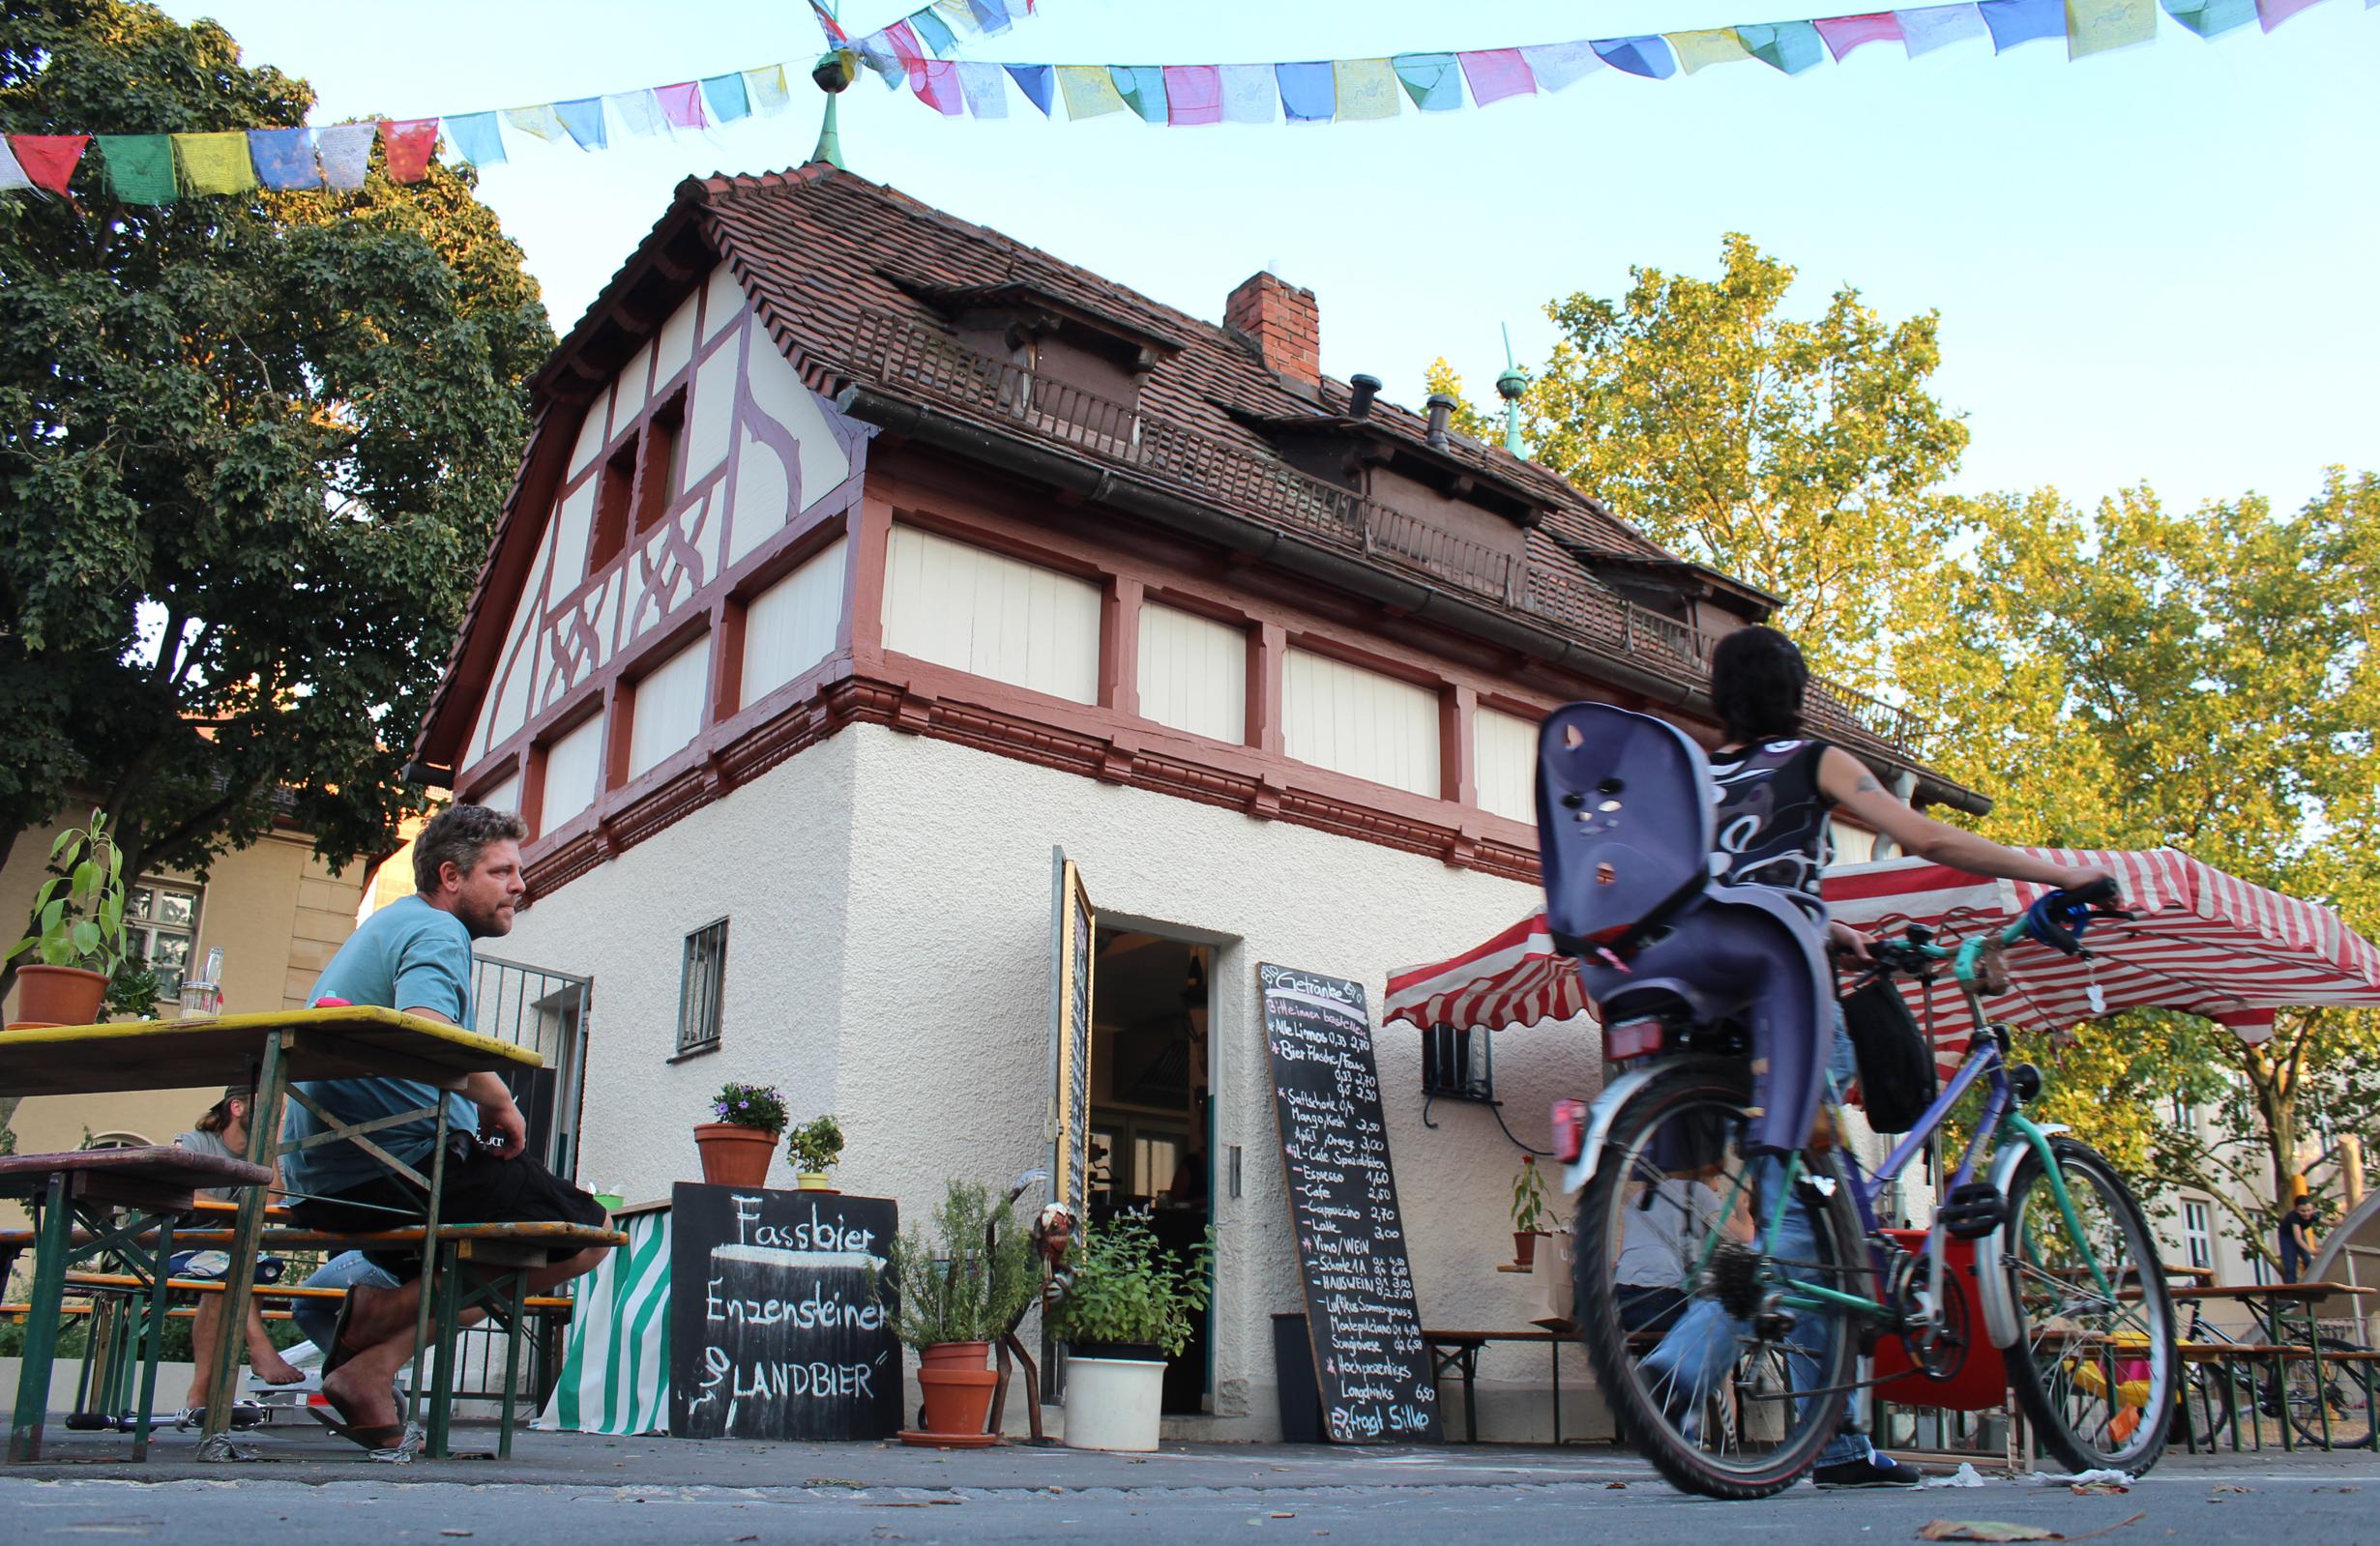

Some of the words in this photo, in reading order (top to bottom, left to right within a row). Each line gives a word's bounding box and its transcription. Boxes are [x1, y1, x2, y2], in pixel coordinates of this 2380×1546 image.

[1276, 972, 1352, 1004] Getränke
[1276, 1018, 1294, 1036] Alle
[1293, 1021, 1328, 1044] Limos
[1329, 1032, 1347, 1048] 0,33
[1350, 1036, 1369, 1053] 2,70
[1279, 1039, 1306, 1061] Bier
[1335, 1068, 1353, 1084] 0,33
[1355, 1072, 1375, 1089] 2,70
[1339, 1100, 1355, 1118] 0,4
[1356, 1119, 1380, 1134] 3,50
[1360, 1136, 1384, 1153] 3,00
[1303, 1165, 1344, 1183] Espresso
[1366, 1171, 1389, 1187] 1,60
[1367, 1187, 1391, 1203] 2,50
[1308, 1200, 1361, 1219] Cappuccino
[1370, 1207, 1395, 1223] 2,70
[730, 1195, 876, 1252] Fassbier
[1311, 1218, 1342, 1234] Latte
[1374, 1226, 1399, 1240] 3,00
[1319, 1256, 1354, 1274] Schorle
[1393, 1277, 1411, 1290] 3,00
[1394, 1289, 1413, 1300] 5,00
[1340, 1380, 1395, 1405] Longdrinks
[1415, 1383, 1435, 1403] 6,50
[1349, 1405, 1384, 1437] fragt
